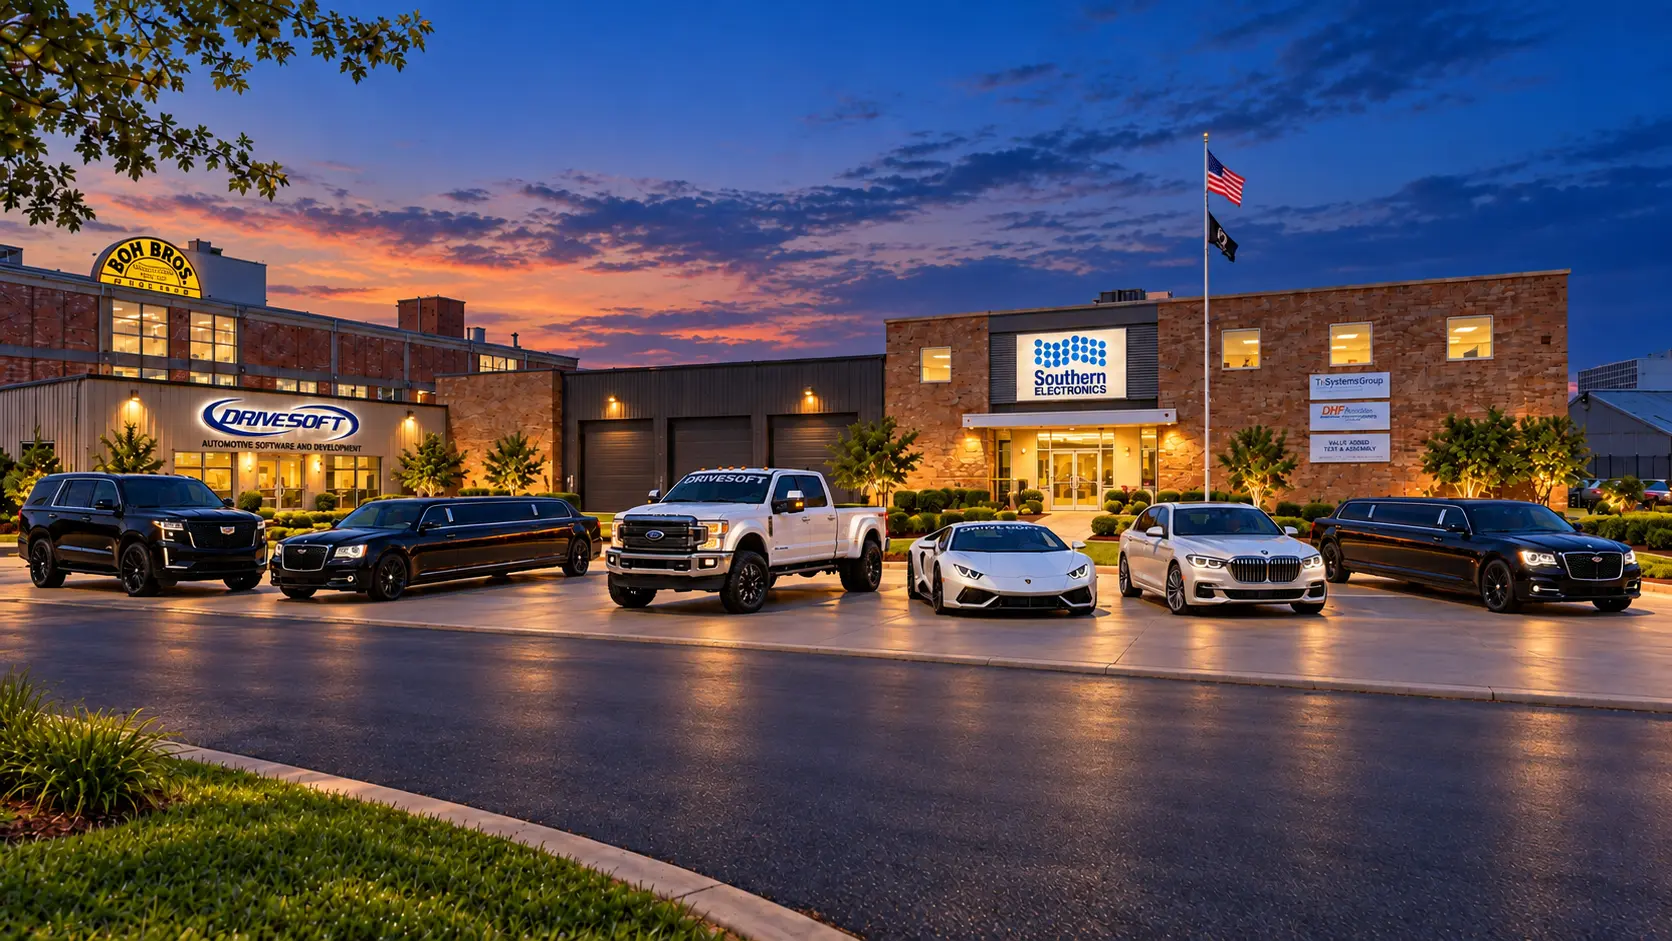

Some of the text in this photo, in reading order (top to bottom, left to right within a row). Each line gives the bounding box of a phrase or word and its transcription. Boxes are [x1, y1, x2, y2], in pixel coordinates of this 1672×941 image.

[107, 241, 193, 285] BOH BROS.
[1034, 369, 1106, 386] Southern
[1034, 385, 1107, 396] ELECTRONICS
[1322, 405, 1345, 416] DHF
[218, 409, 346, 431] DRIVESOFT
[202, 440, 362, 452] AUTOMOTIVE SOFTWARE AND DEVELOPMENT
[684, 474, 768, 484] DRIVESOFT
